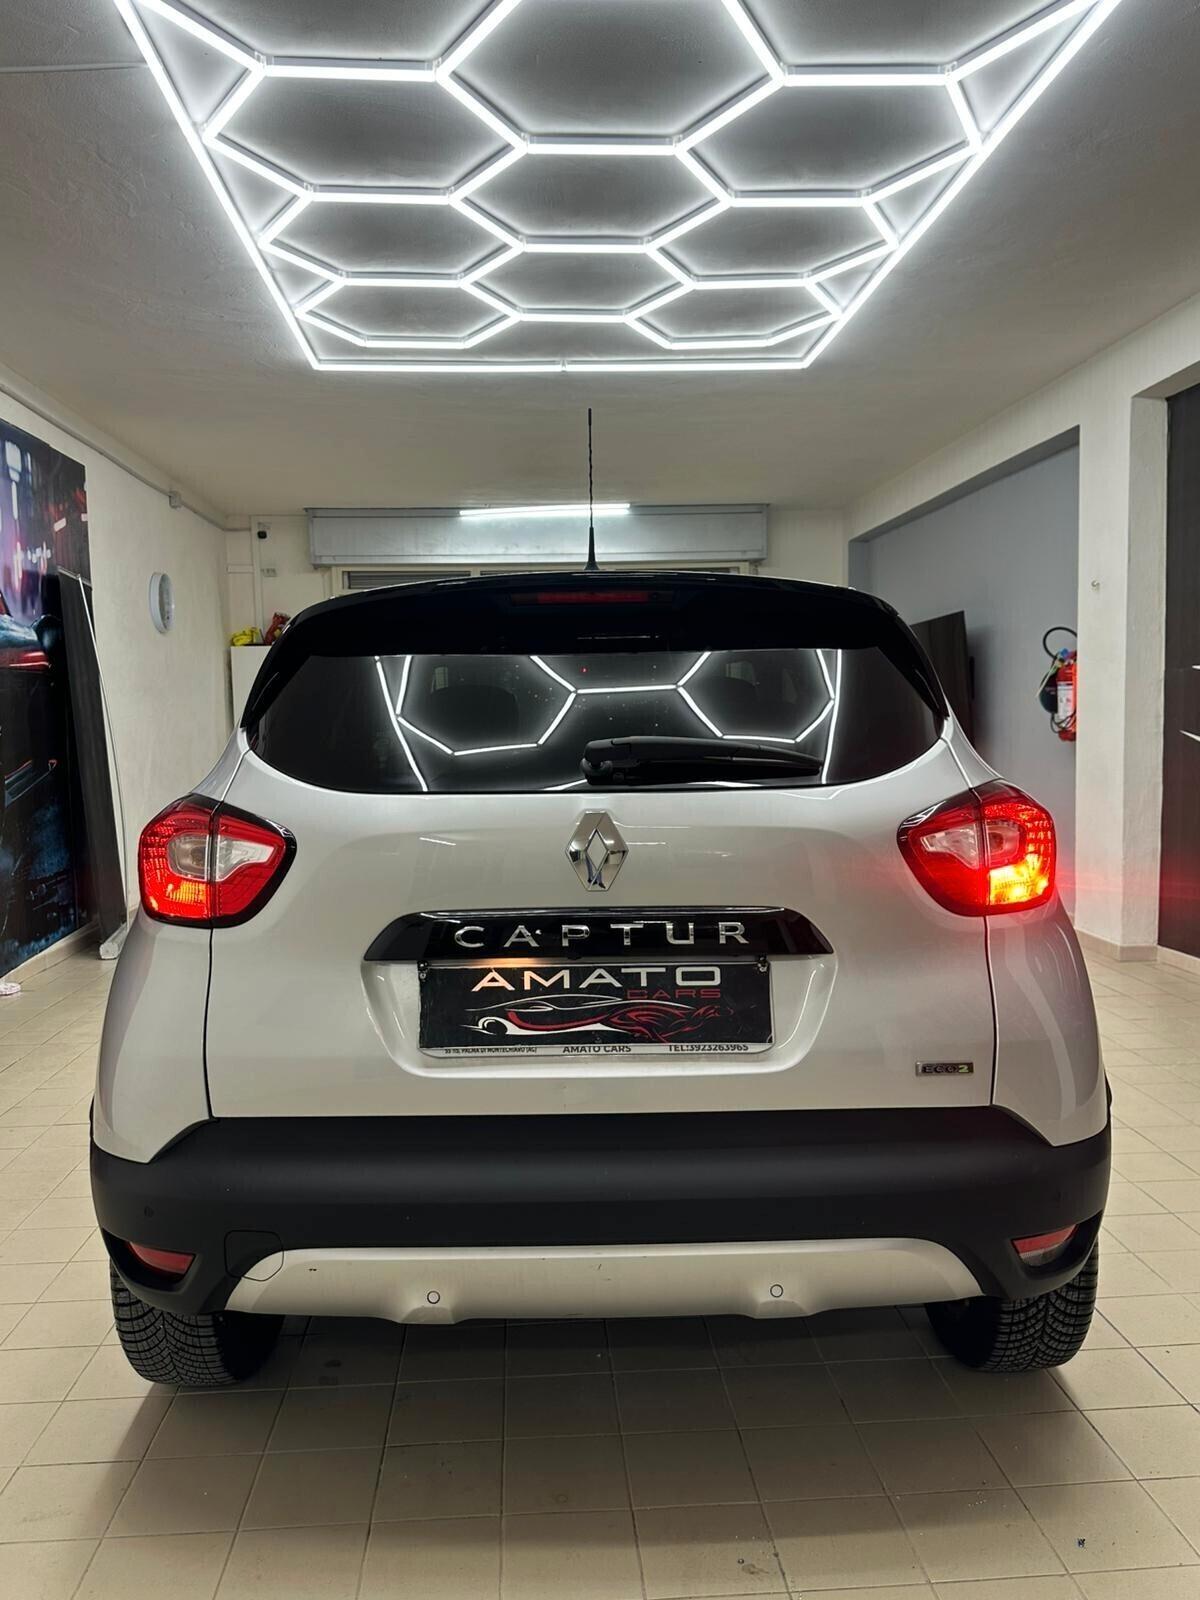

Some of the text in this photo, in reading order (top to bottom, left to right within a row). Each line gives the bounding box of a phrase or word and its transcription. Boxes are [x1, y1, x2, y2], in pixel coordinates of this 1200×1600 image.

[454, 921, 750, 948] CAPTUR
[471, 966, 722, 992] AMATO
[627, 989, 721, 999] CARS
[562, 1045, 601, 1053] AMATO
